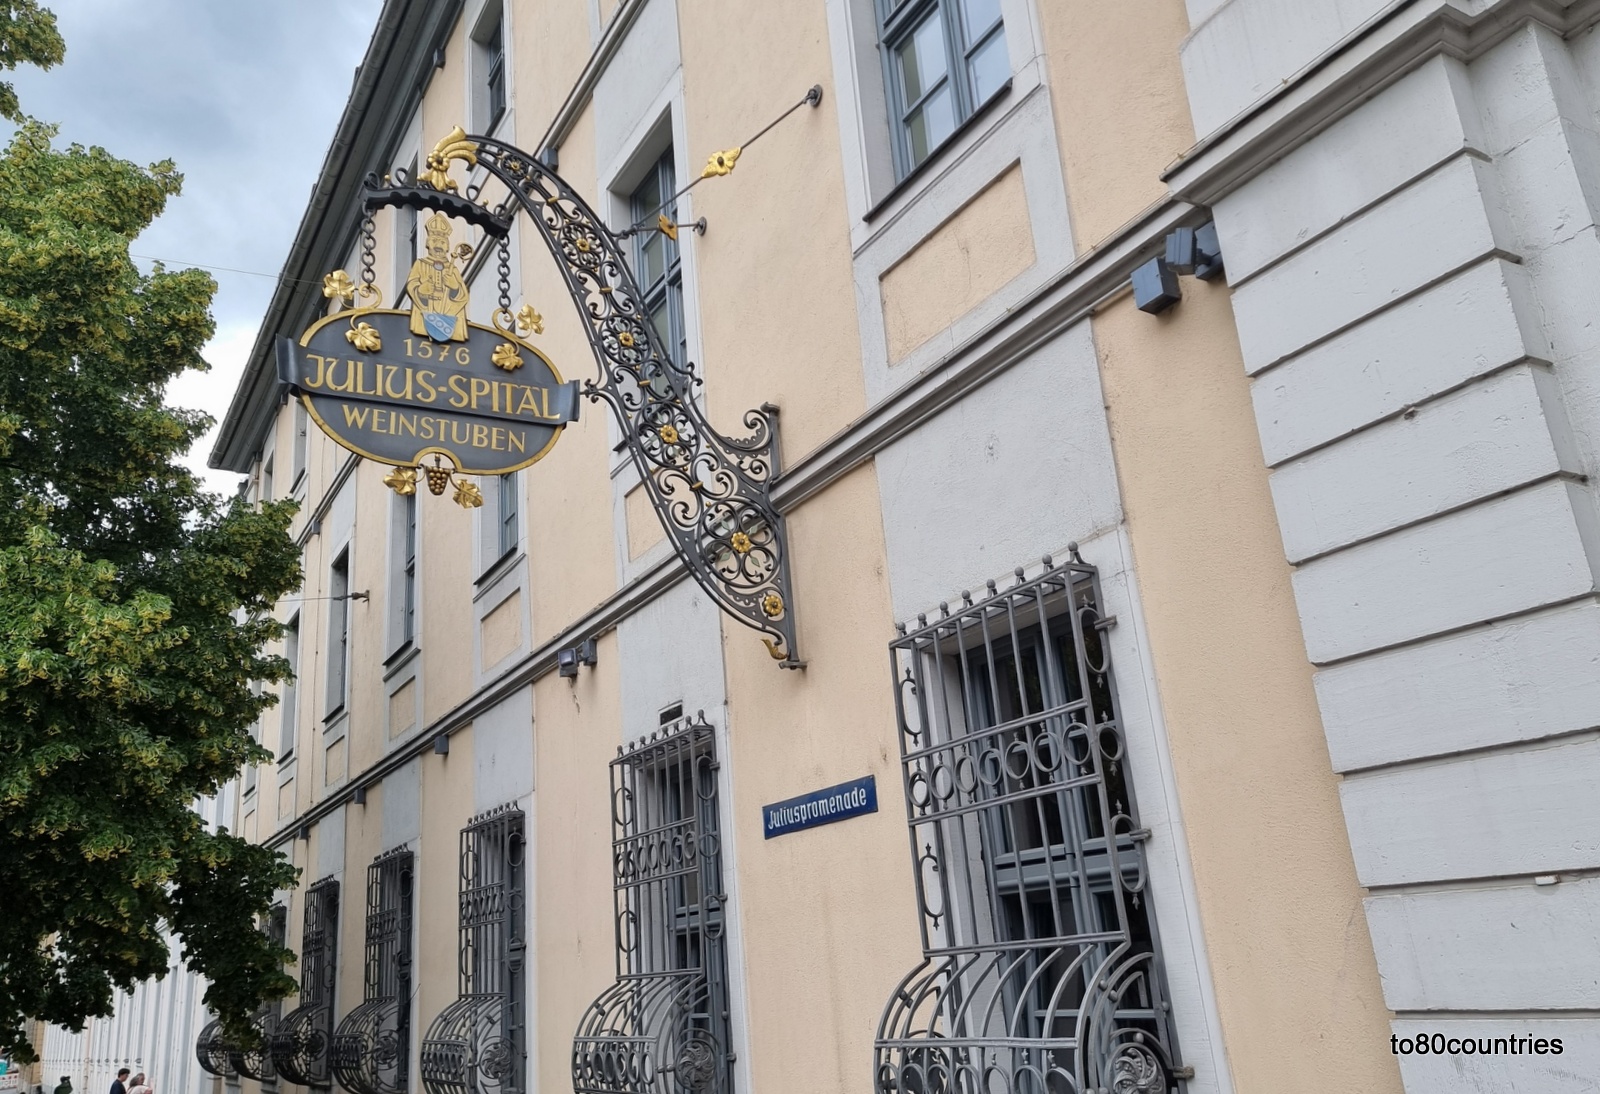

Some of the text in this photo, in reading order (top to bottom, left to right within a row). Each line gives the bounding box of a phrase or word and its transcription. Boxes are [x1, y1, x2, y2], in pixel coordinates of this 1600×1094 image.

[404, 338, 470, 365] 1576
[342, 404, 526, 453] WEINSTUBEN
[768, 787, 867, 830] Juliuspromenade
